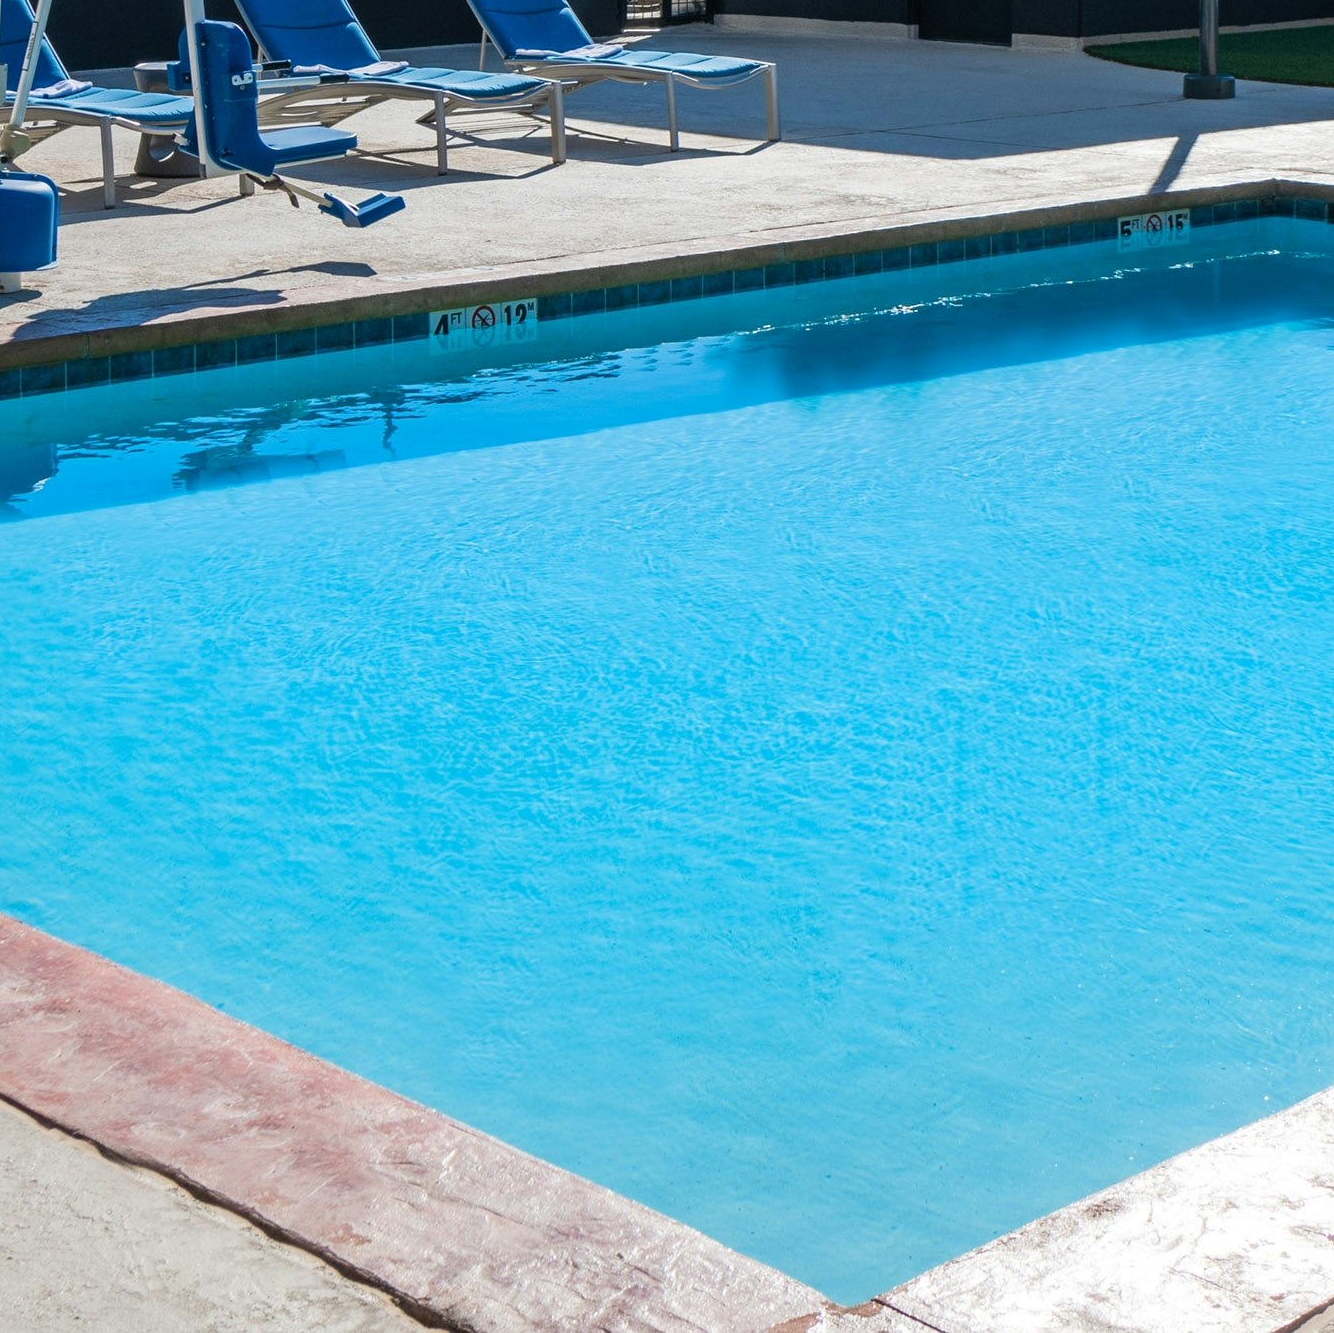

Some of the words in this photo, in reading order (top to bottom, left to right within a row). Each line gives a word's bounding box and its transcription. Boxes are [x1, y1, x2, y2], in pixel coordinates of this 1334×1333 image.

[1120, 220, 1132, 236] 5
[1168, 213, 1184, 230] 15
[433, 314, 449, 335] 4
[451, 312, 463, 325] FT
[504, 303, 527, 326] 12
